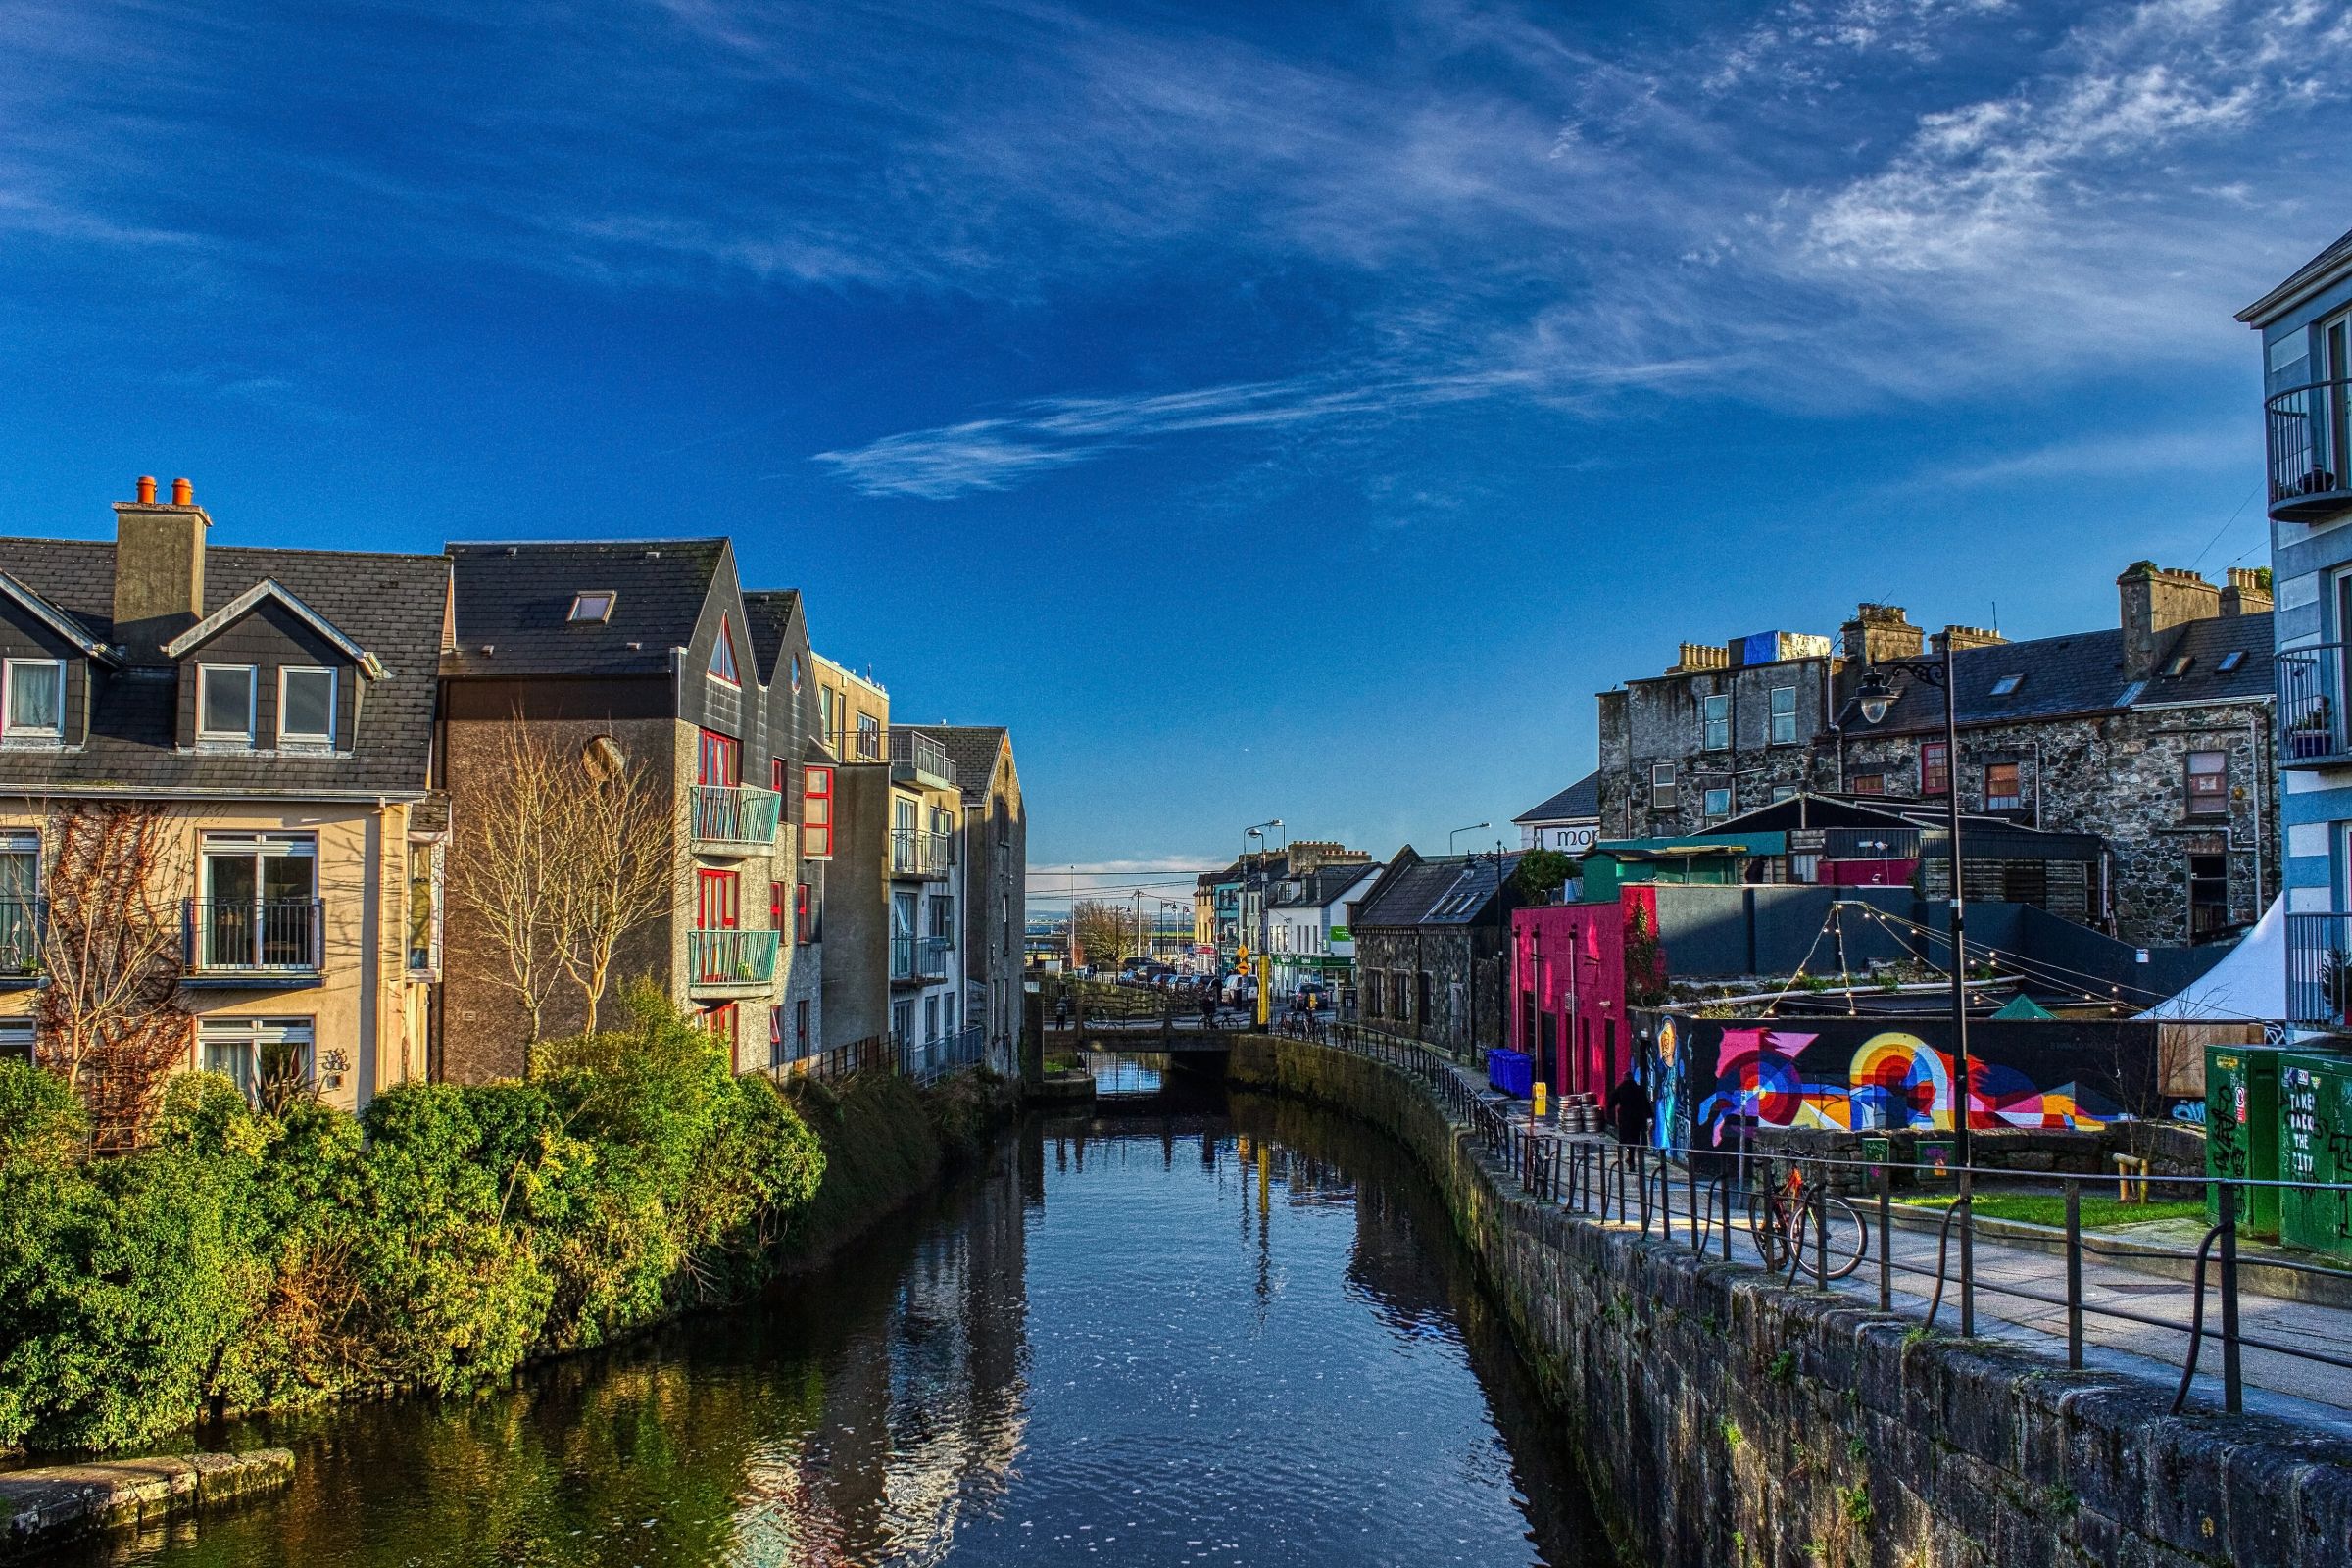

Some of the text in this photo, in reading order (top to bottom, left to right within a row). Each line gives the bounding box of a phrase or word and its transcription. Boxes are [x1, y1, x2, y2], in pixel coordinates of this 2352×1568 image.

[2289, 1092, 2314, 1111] TAKE
[2290, 1113, 2314, 1131] BACK
[2293, 1133, 2309, 1150] THE
[2292, 1152, 2314, 1172] CITY
